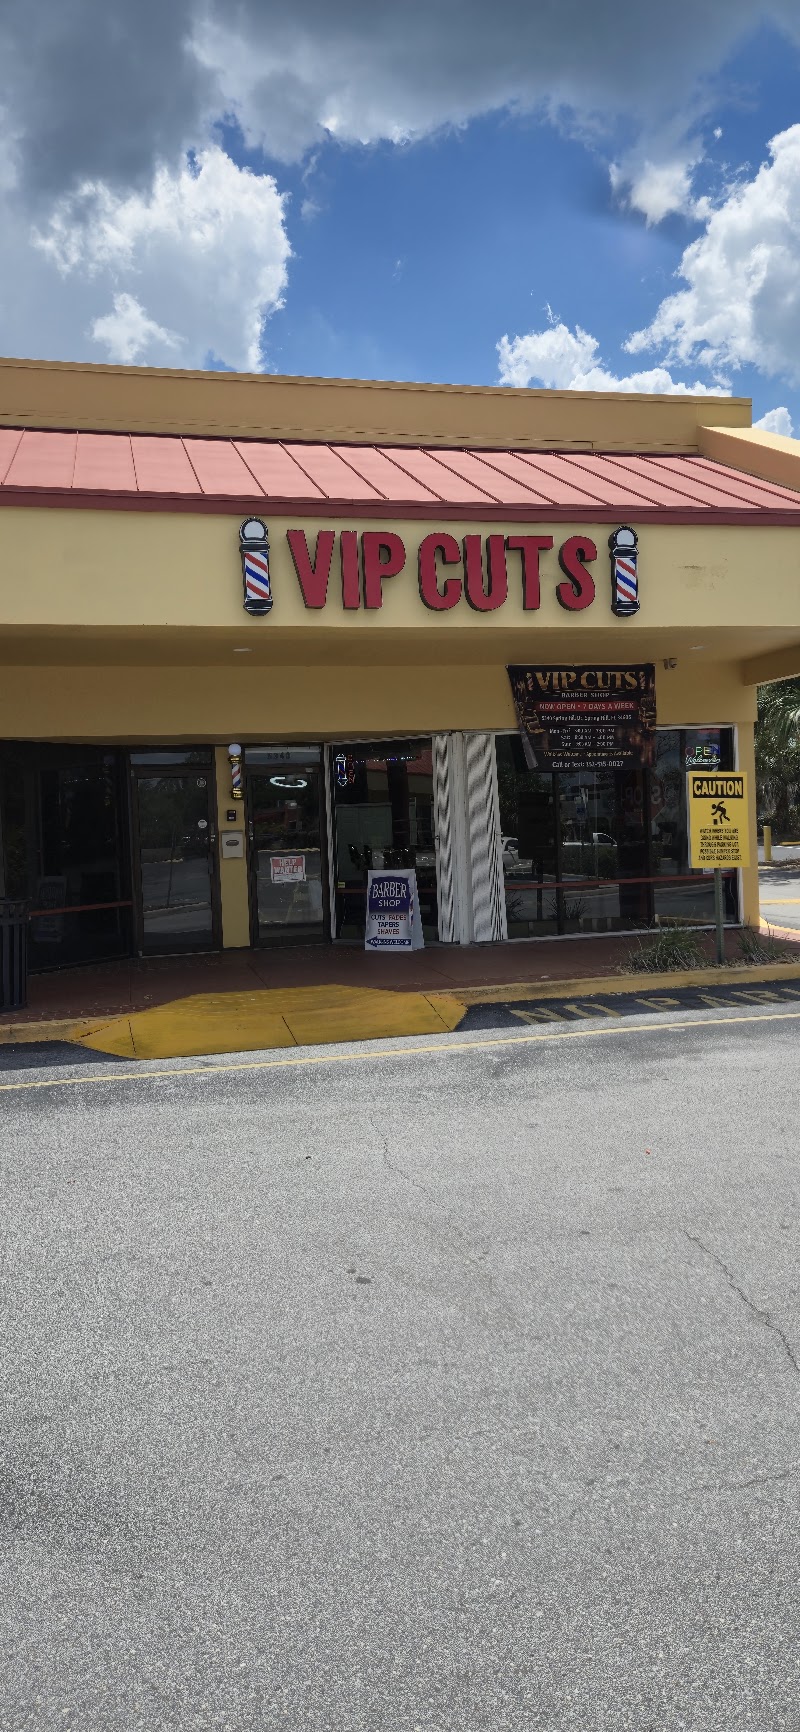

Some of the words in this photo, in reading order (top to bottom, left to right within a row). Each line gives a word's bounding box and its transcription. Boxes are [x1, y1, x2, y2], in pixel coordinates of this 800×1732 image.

[286, 529, 406, 610] VIP
[418, 532, 598, 612] CUTS
[534, 671, 577, 690] VIP
[580, 671, 638, 690] CUTS
[557, 702, 576, 710] OPEN
[588, 702, 606, 710] DAYS
[684, 746, 721, 756] OPEN
[693, 780, 743, 796] CAUTION
[279, 858, 297, 867] HELP
[273, 865, 303, 874] WANTED
[372, 881, 407, 899] BARBER
[378, 899, 401, 907] SHOP
[510, 1003, 623, 1025] NO
